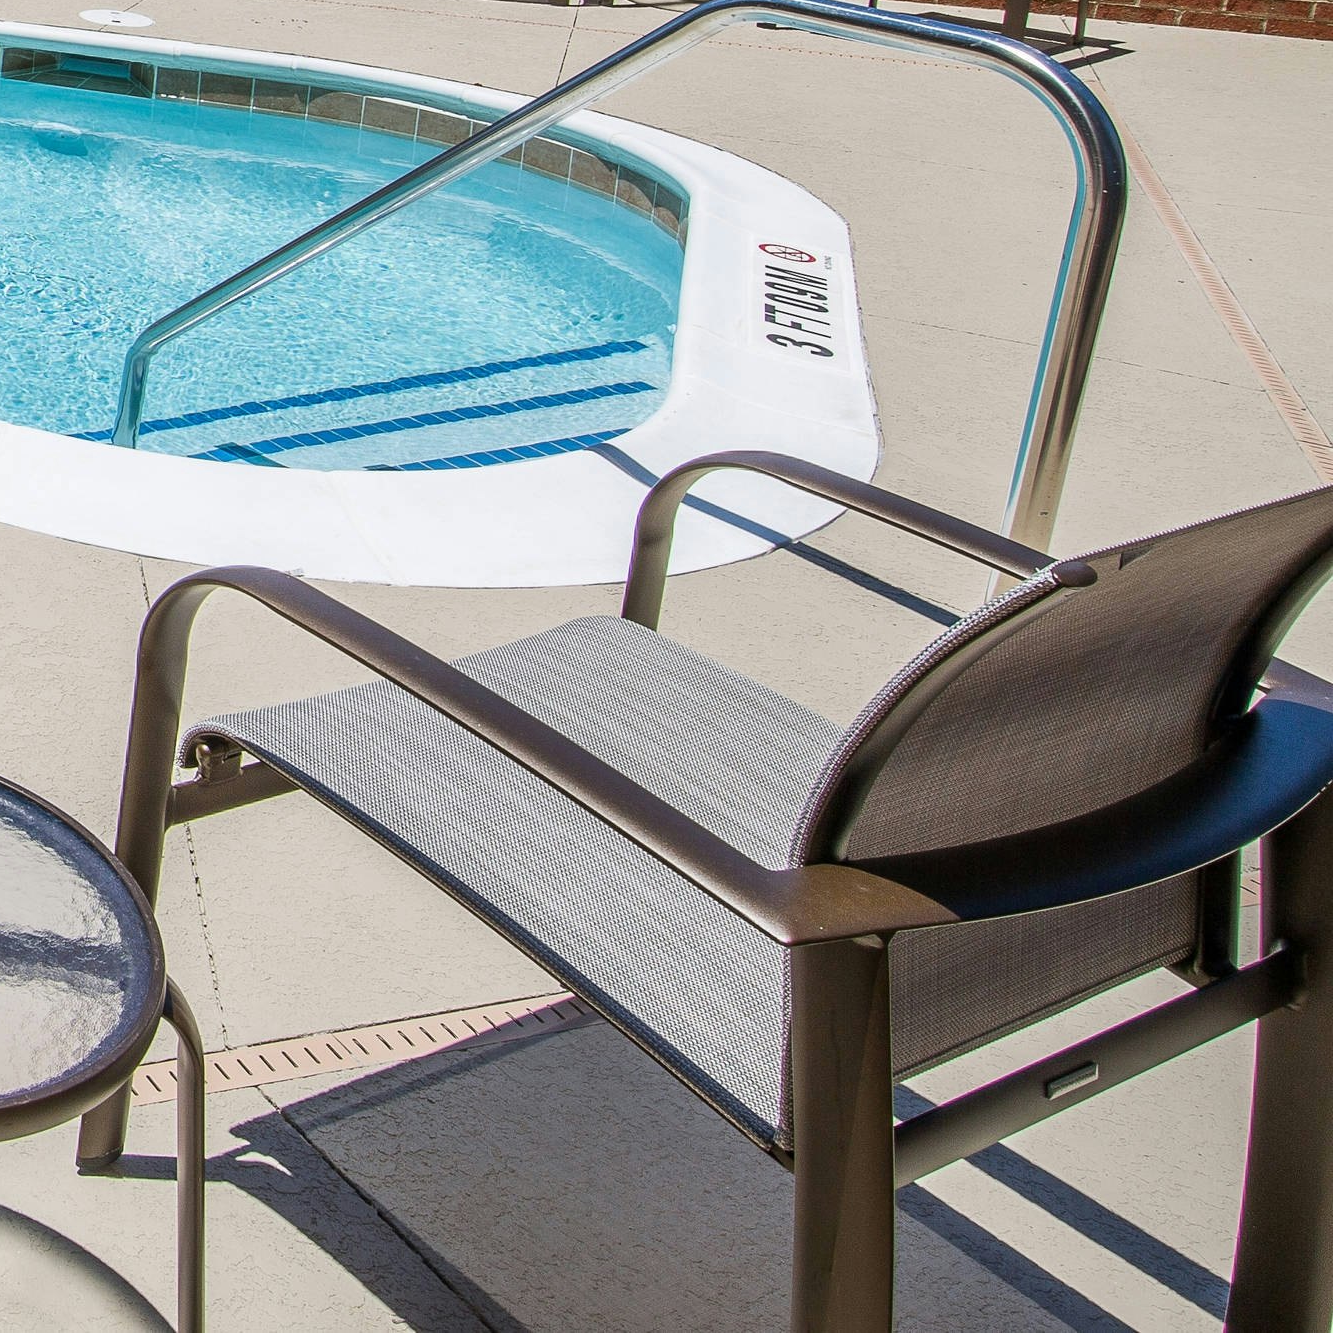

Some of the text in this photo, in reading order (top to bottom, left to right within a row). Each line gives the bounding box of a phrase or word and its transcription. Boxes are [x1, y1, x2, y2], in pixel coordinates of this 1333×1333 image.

[764, 264, 829, 291] M
[764, 303, 832, 339] FT
[765, 333, 835, 358] 3
